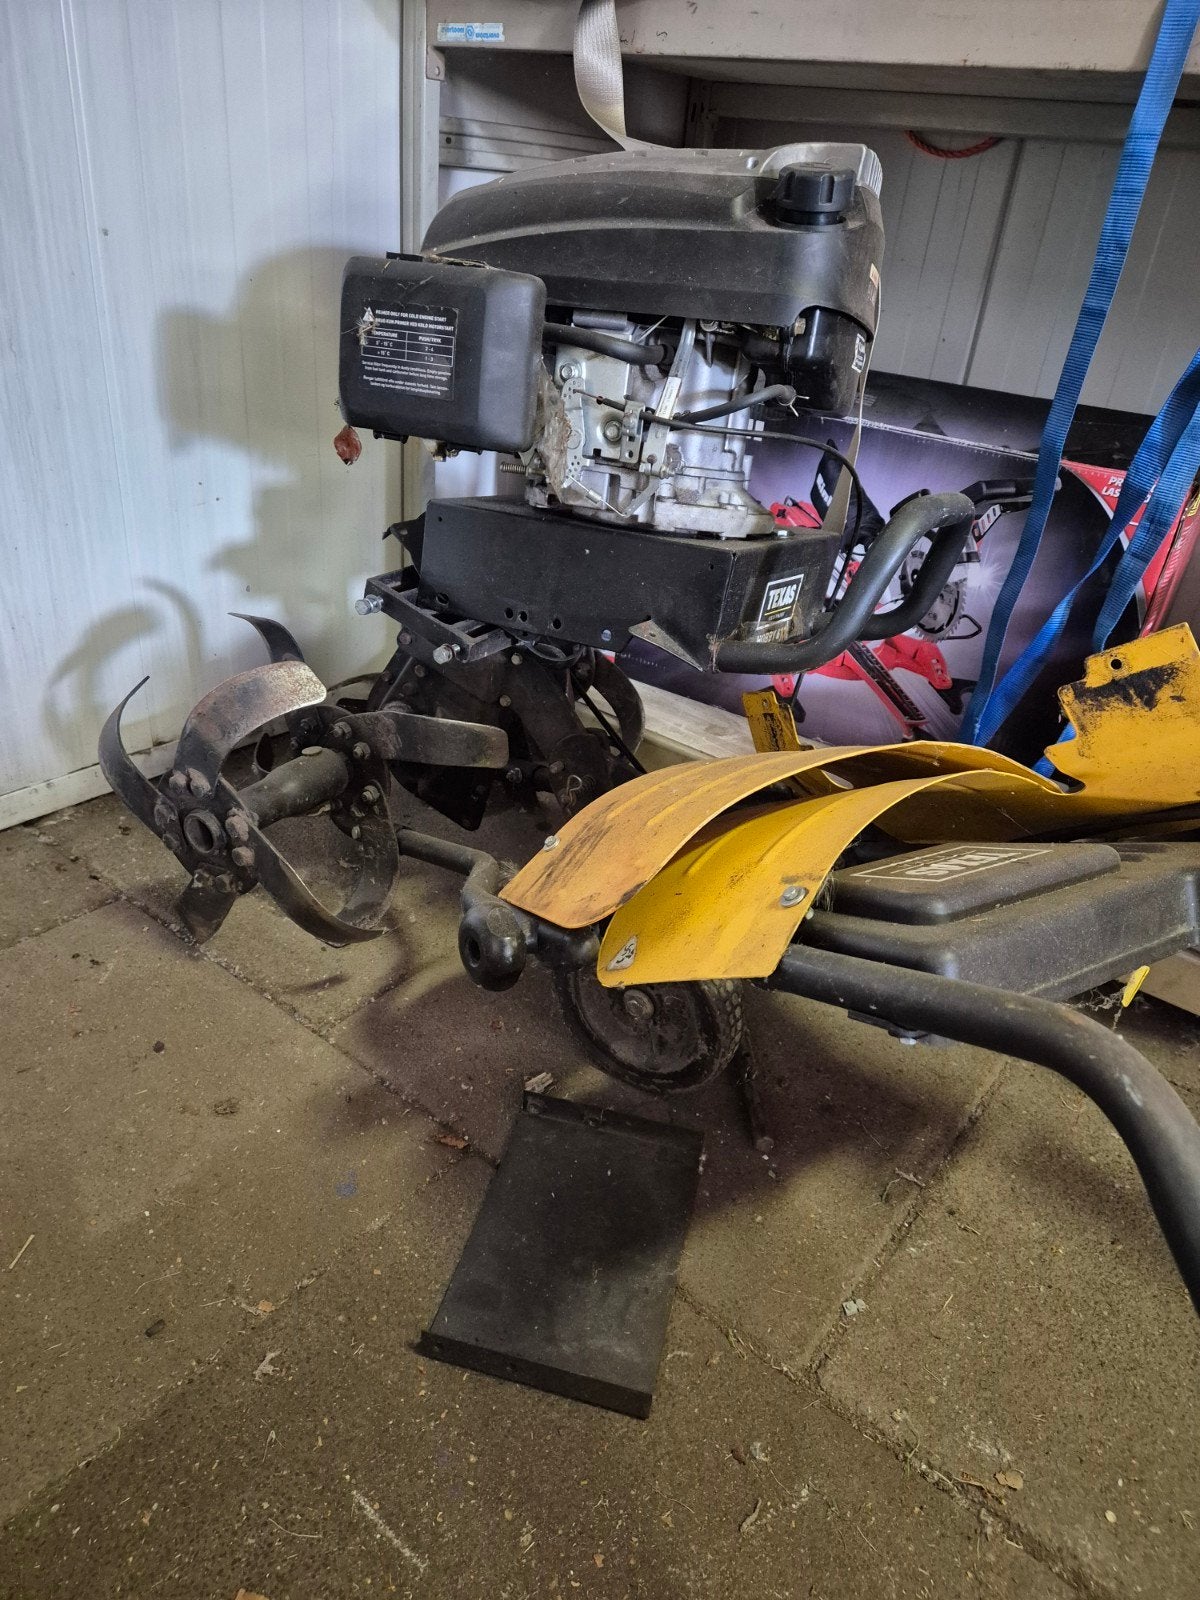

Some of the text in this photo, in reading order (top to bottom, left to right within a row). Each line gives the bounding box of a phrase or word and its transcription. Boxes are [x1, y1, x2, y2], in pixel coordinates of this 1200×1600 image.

[1108, 476, 1125, 487] PR
[1101, 486, 1121, 498] LAS
[767, 583, 797, 610] TEXAS
